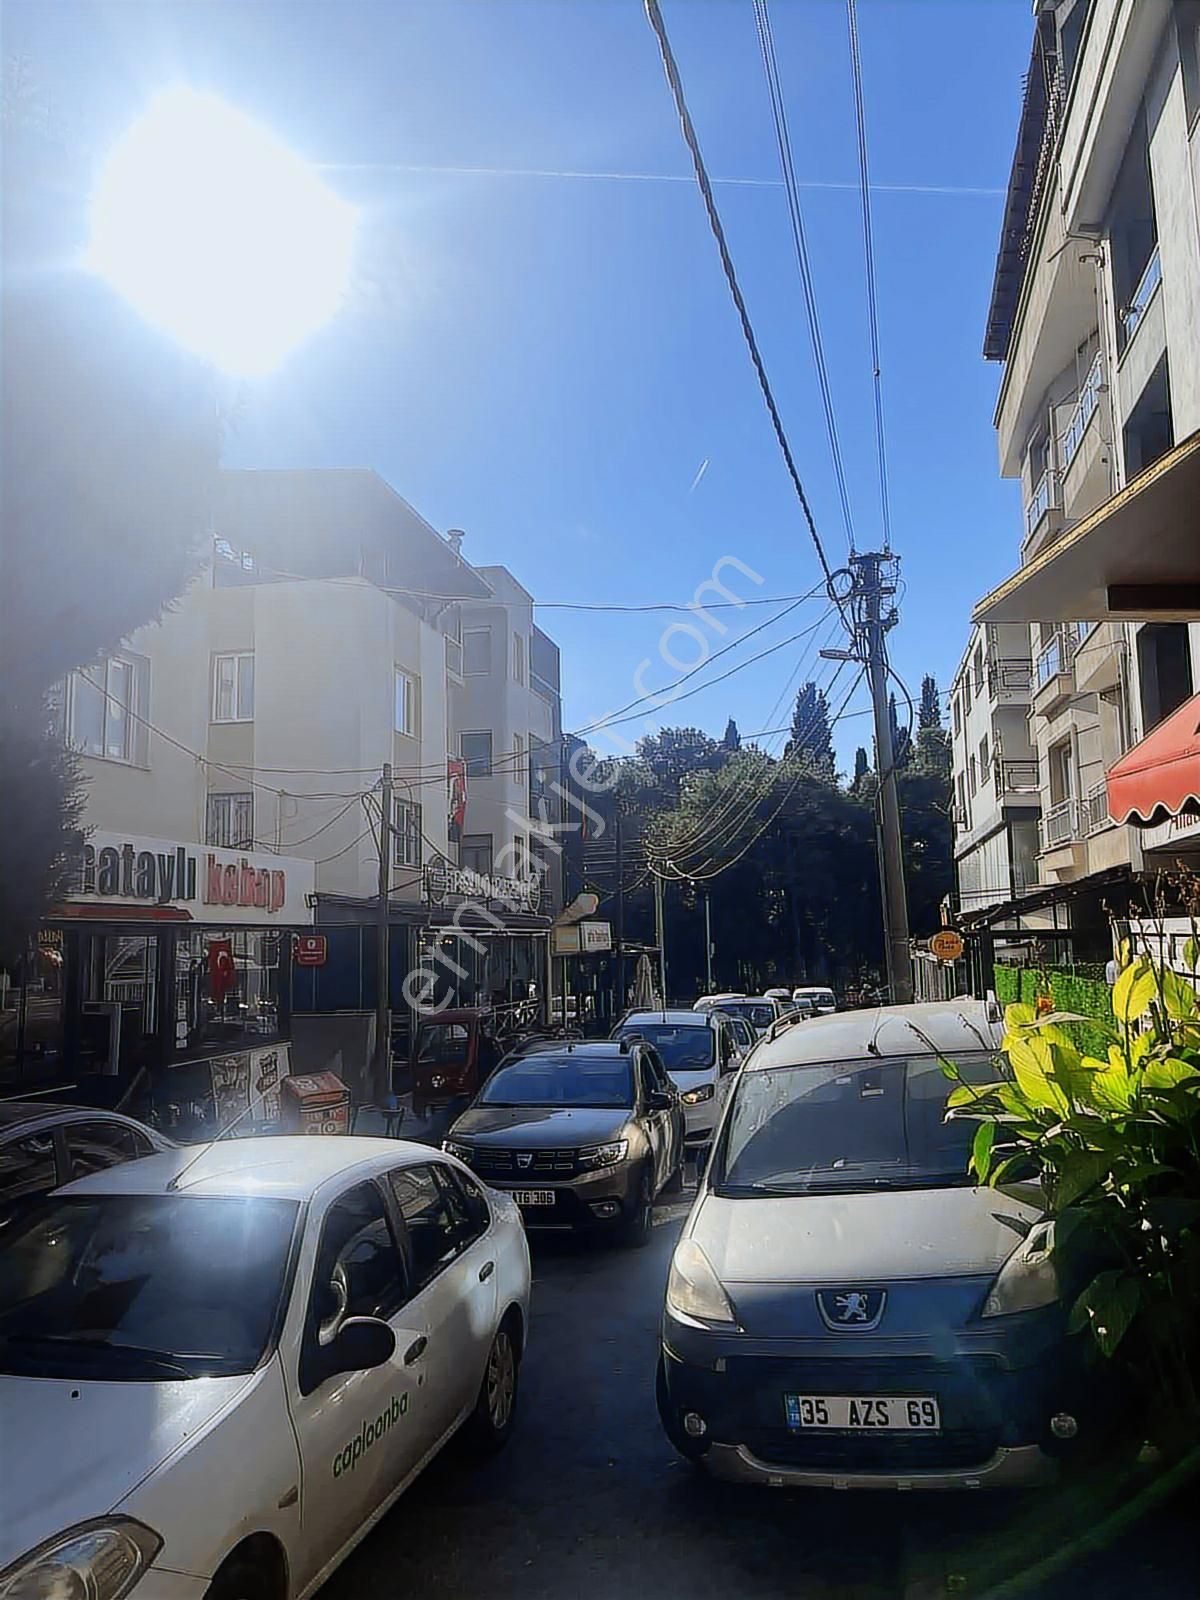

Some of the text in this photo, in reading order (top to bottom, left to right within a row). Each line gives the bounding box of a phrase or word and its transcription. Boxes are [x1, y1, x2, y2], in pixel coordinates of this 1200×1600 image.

[533, 1191, 554, 1204] 306
[801, 1399, 829, 1425] 35
[849, 1400, 890, 1427] AZS
[906, 1400, 936, 1427] 69
